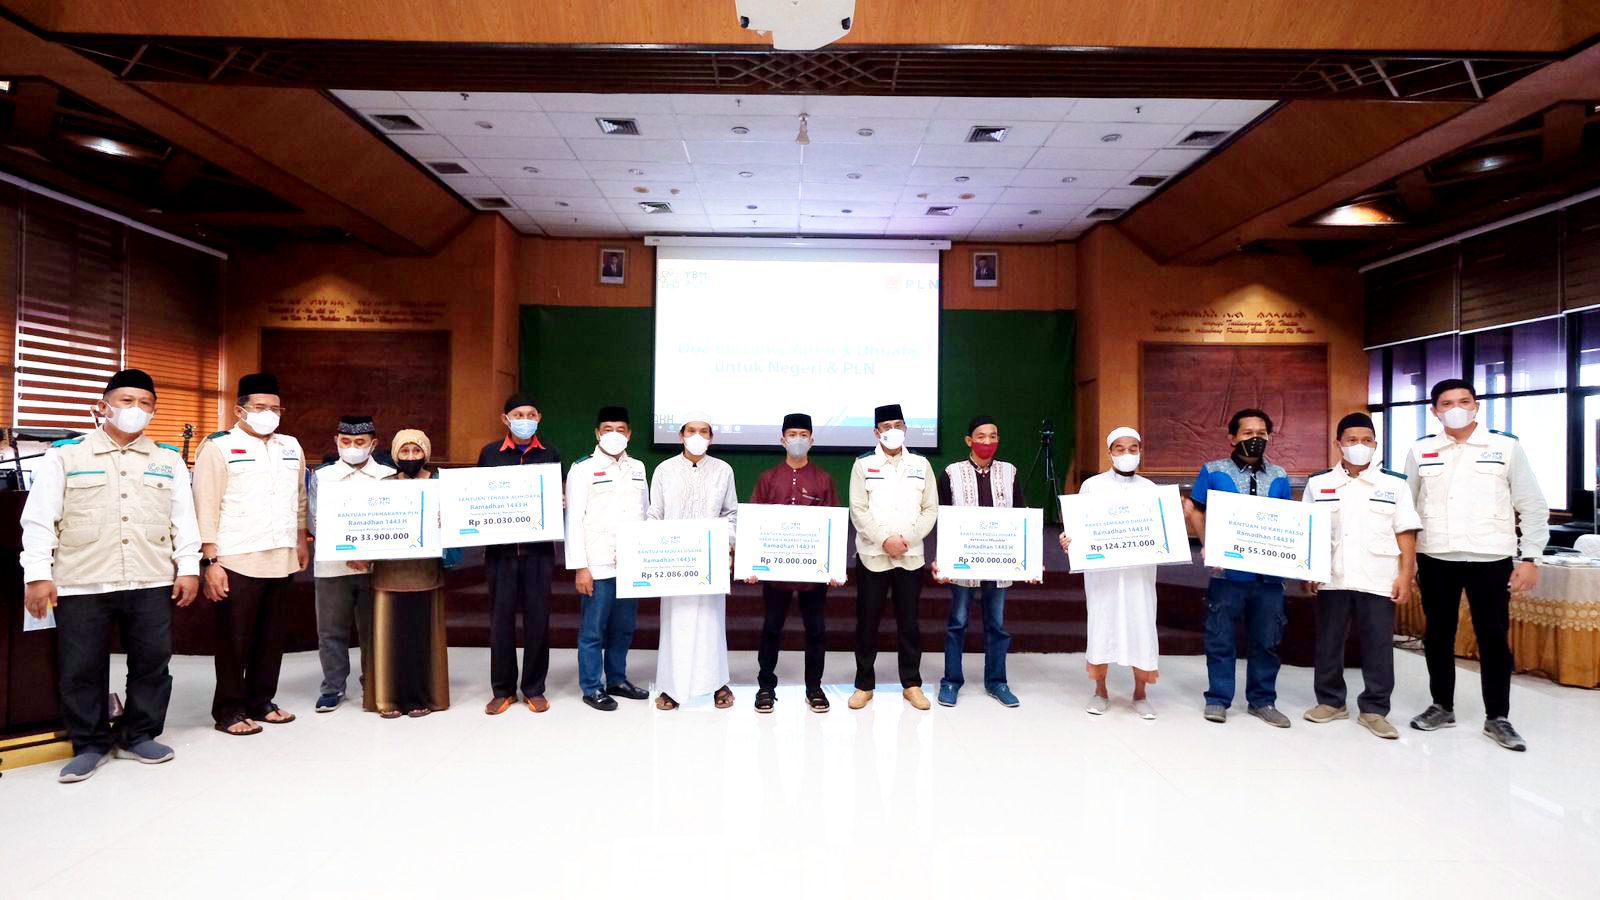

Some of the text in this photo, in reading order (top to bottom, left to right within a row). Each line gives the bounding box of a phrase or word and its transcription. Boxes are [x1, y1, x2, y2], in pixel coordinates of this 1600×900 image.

[905, 279, 939, 290] PLN
[714, 360, 876, 376] untuk Negeri & PLN
[469, 516, 531, 527] Rp 30.030.000
[1228, 520, 1259, 529] BANTUAN
[345, 533, 409, 543] Rp 33.900.000
[1236, 530, 1271, 540] Ramadhan
[1091, 540, 1155, 552] Rp 124.271.000
[1248, 547, 1296, 560] 55.500.000
[959, 556, 969, 564] Rp
